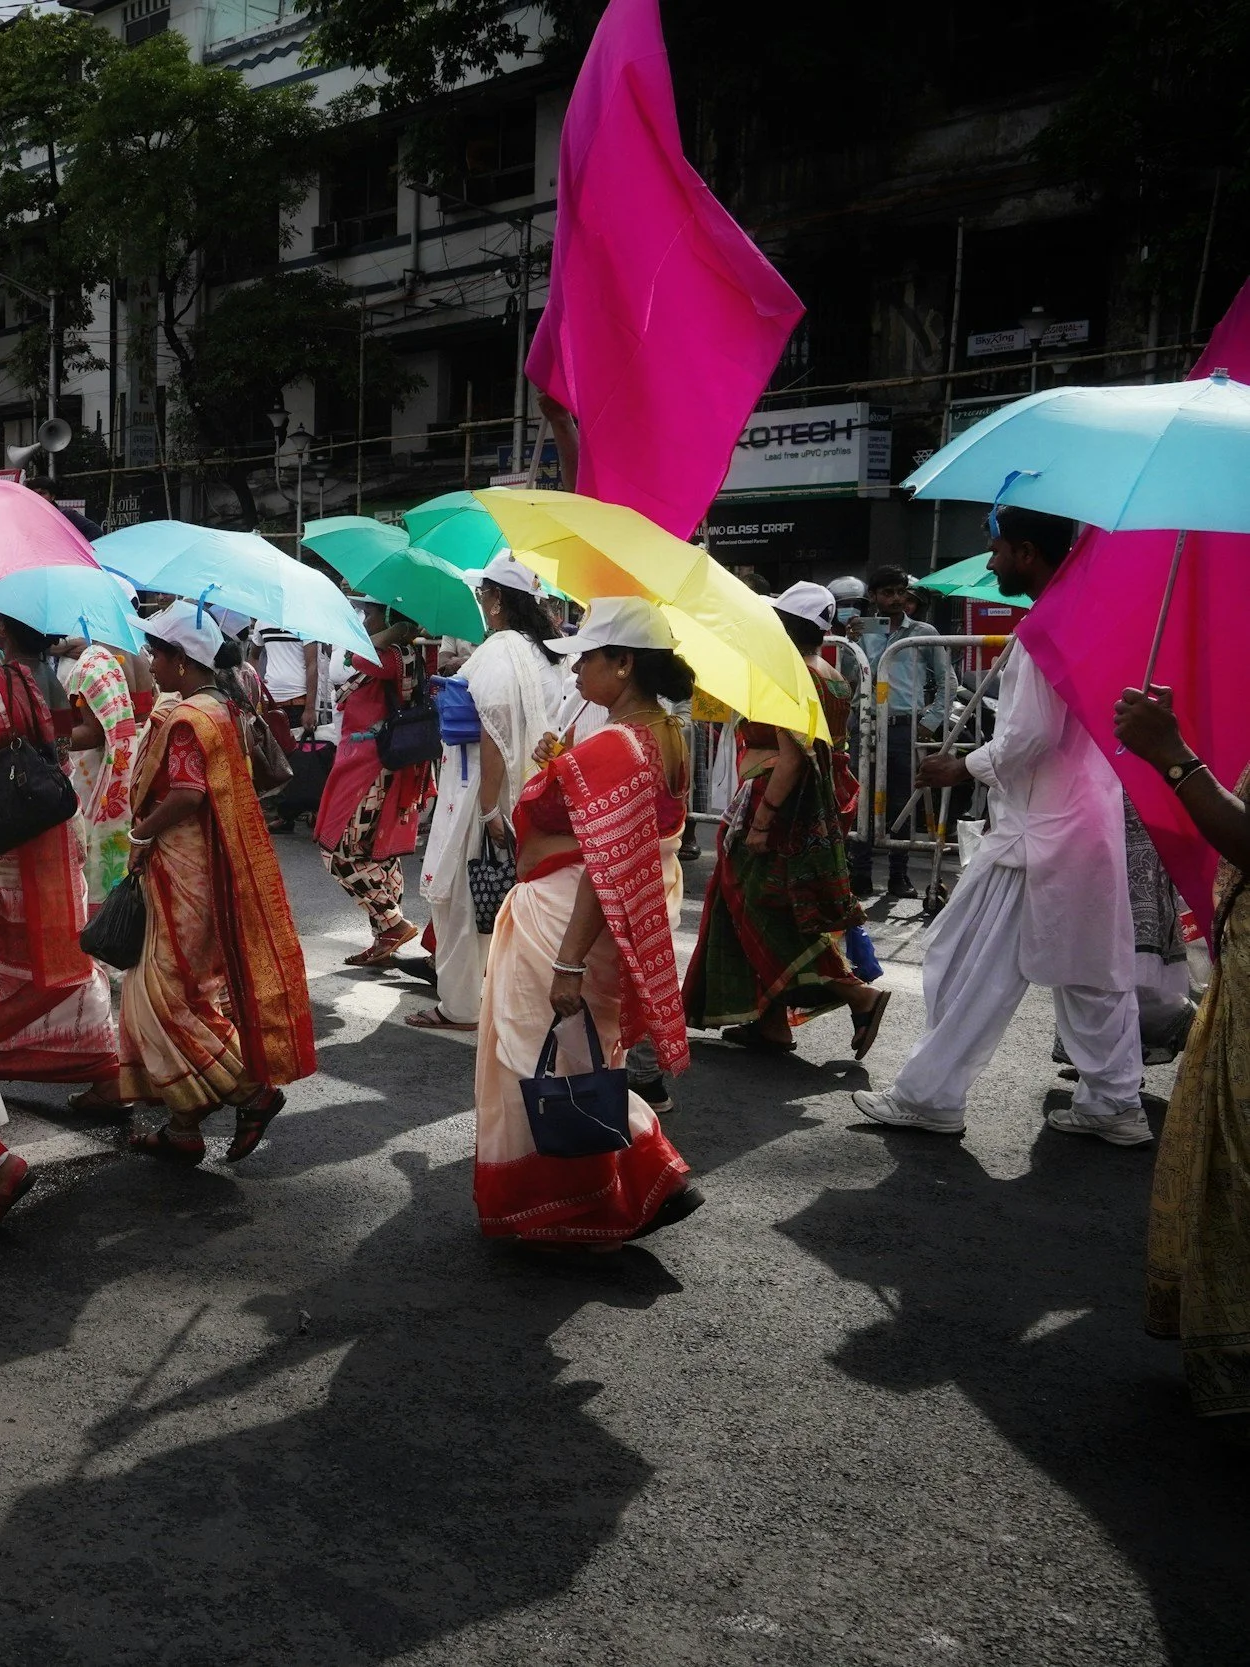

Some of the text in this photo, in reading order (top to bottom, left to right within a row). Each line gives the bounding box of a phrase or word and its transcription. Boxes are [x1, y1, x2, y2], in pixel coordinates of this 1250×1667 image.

[764, 447, 852, 461] Lead free uPVC profiles
[726, 524, 760, 535] GLASS
[761, 522, 795, 534] CRAFT
